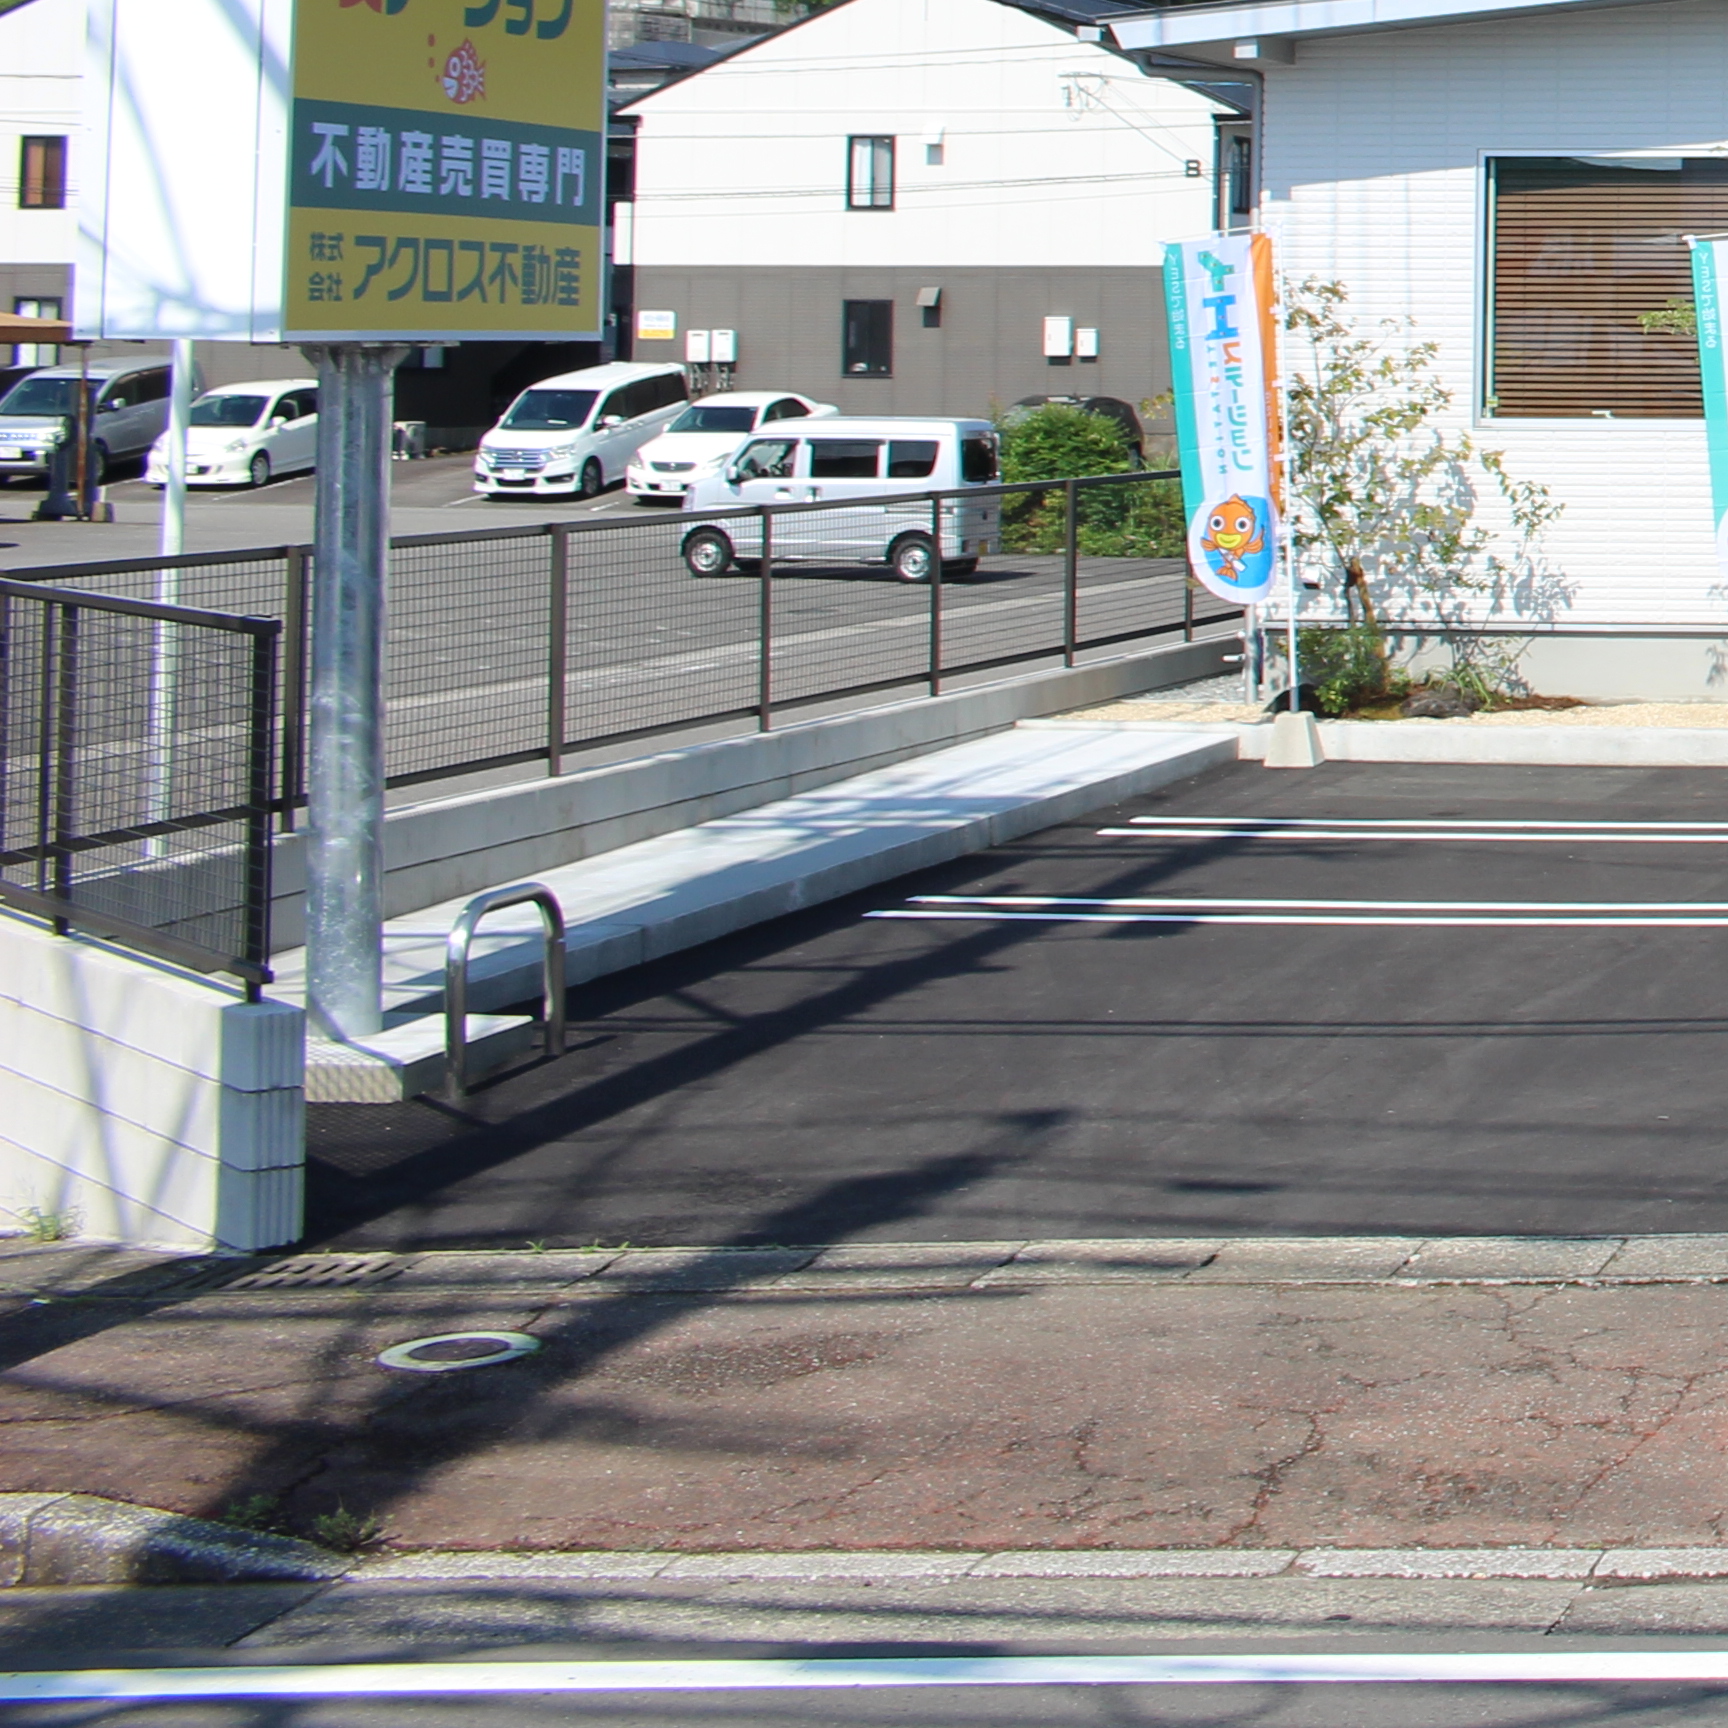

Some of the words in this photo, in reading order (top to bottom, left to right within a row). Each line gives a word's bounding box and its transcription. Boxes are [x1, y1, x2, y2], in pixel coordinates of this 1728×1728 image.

[310, 121, 586, 207] 不動産売買専門
[1186, 159, 1201, 178] B
[353, 235, 582, 308] アクロス不動産
